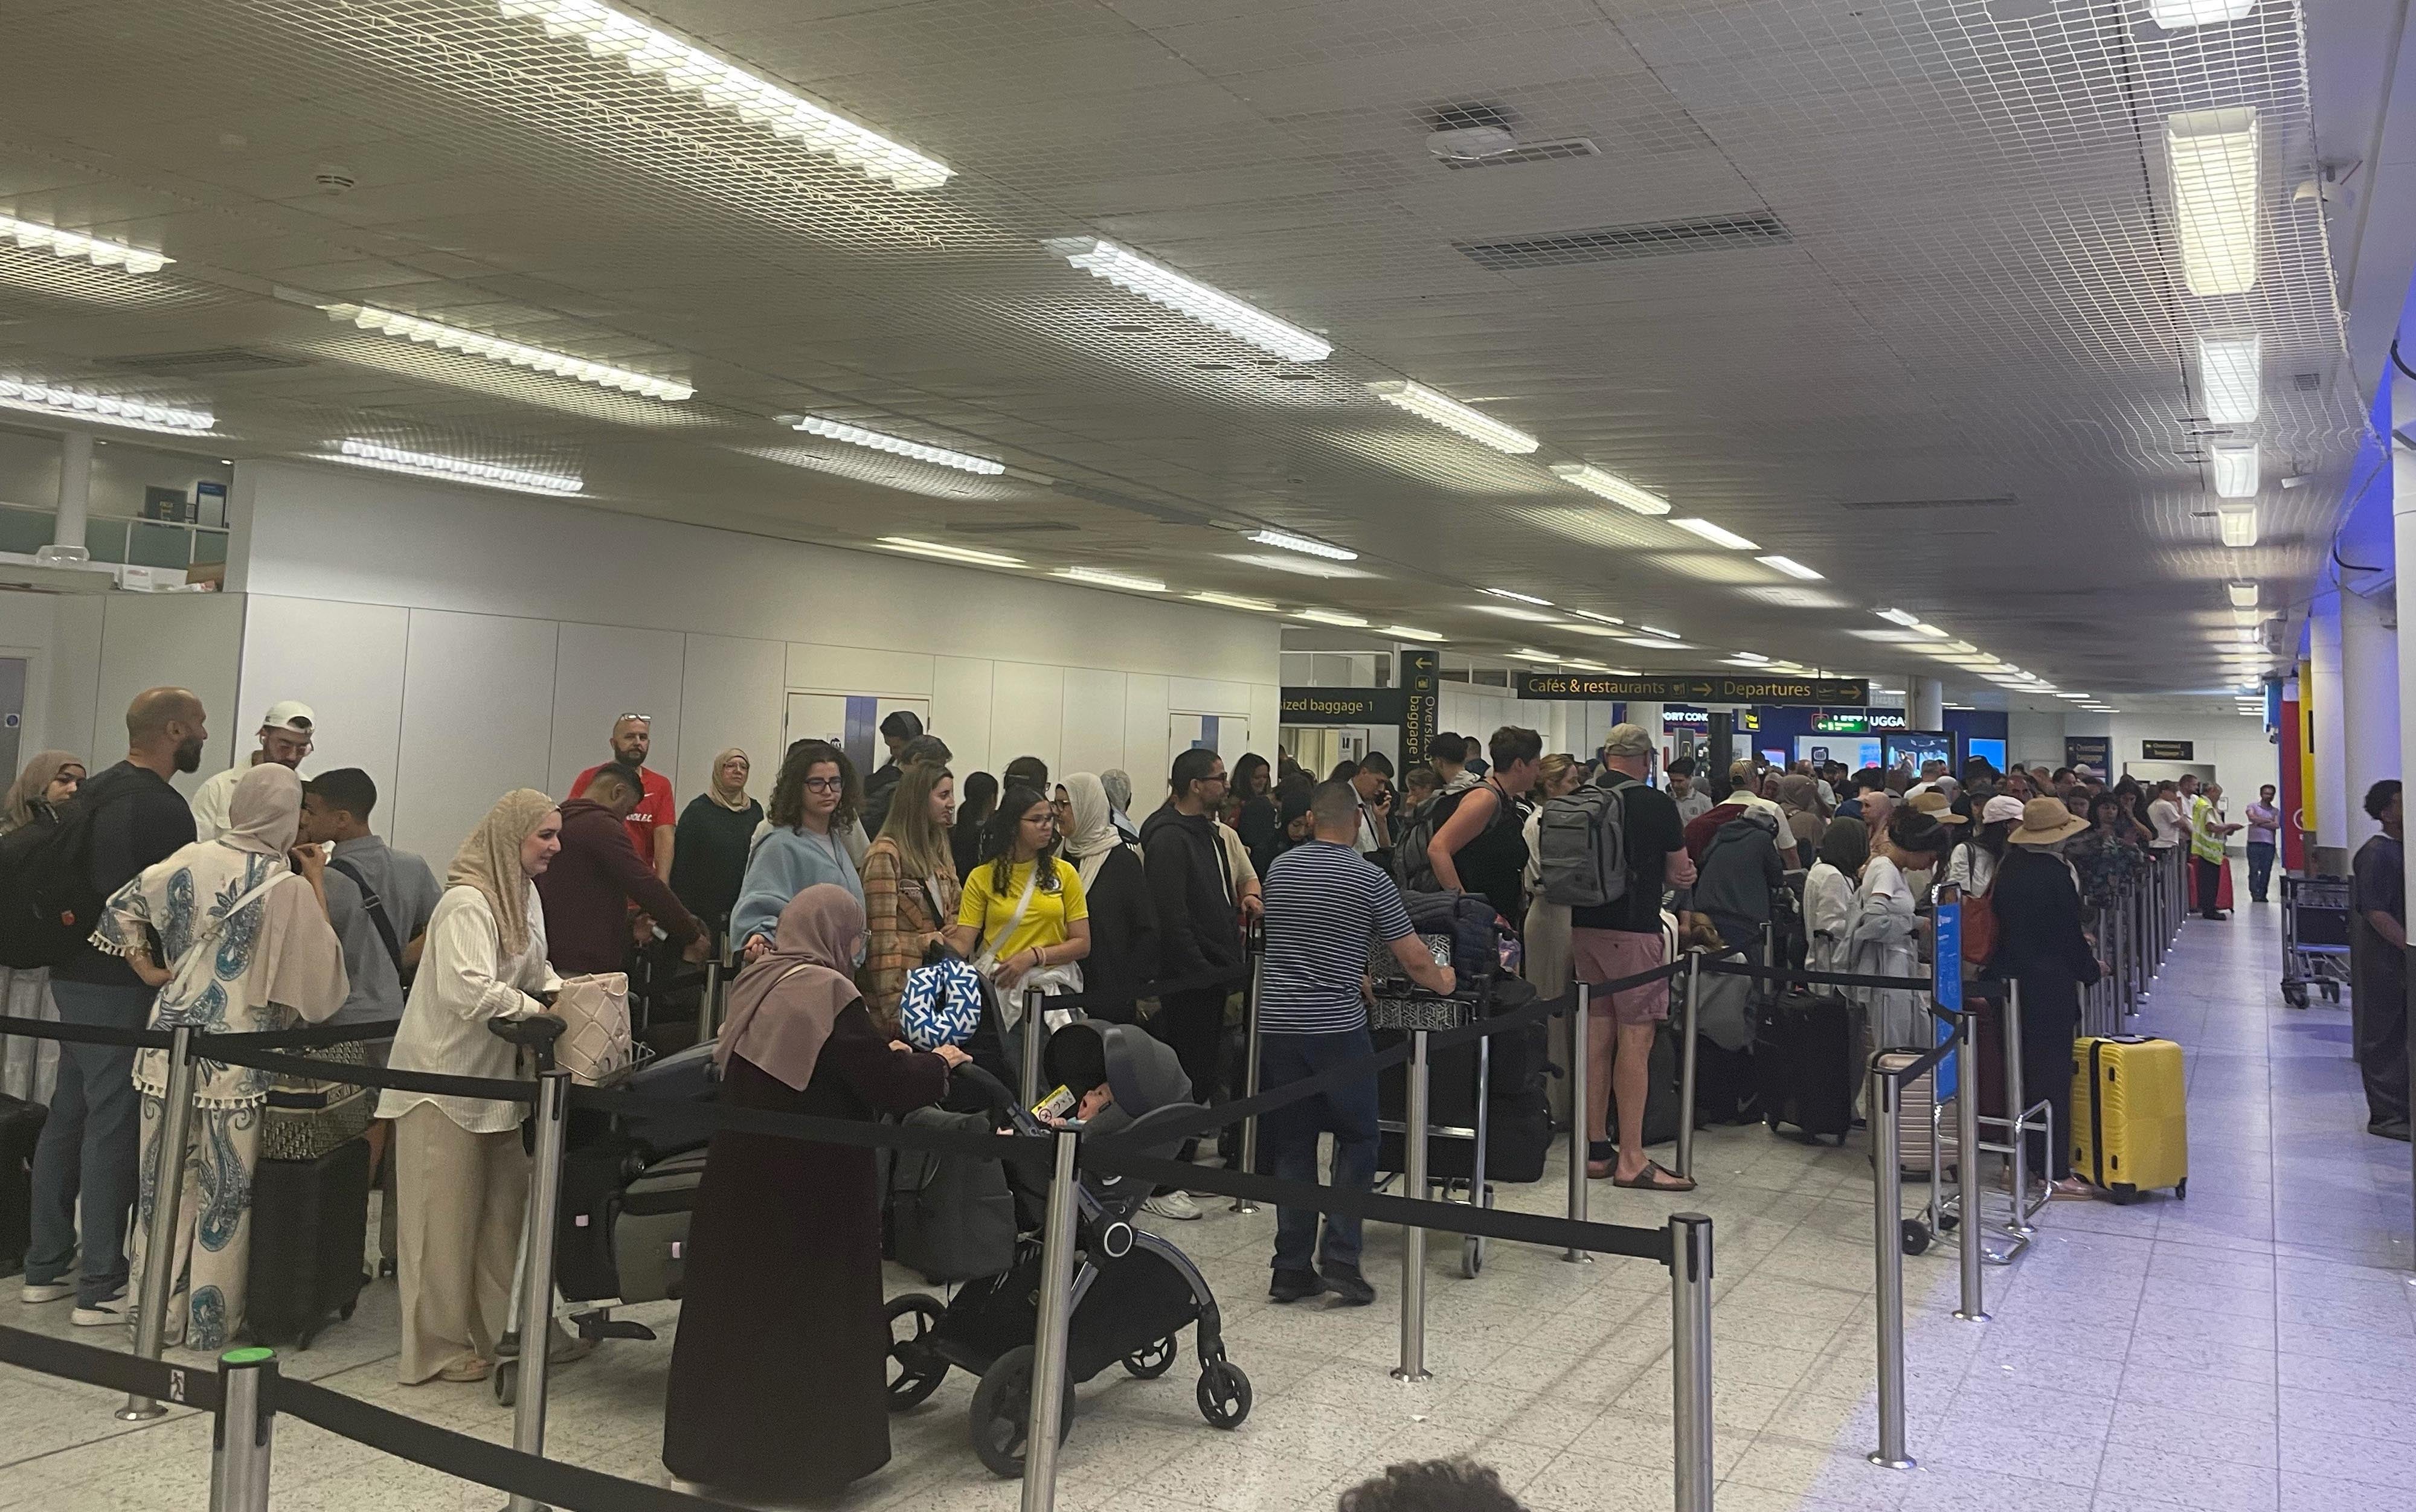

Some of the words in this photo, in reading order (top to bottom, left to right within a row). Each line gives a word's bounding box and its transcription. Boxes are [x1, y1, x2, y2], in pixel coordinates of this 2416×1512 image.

[1528, 679, 1566, 693] Cafés
[1570, 679, 1581, 693] &
[1584, 681, 1665, 694] restaurants
[1724, 681, 1811, 699] Departures
[1310, 699, 1363, 714] baggage
[1368, 701, 1373, 711] 1
[1662, 712, 1685, 721] ORT
[1864, 715, 1906, 727] UGGA
[1407, 696, 1422, 755] baggage
